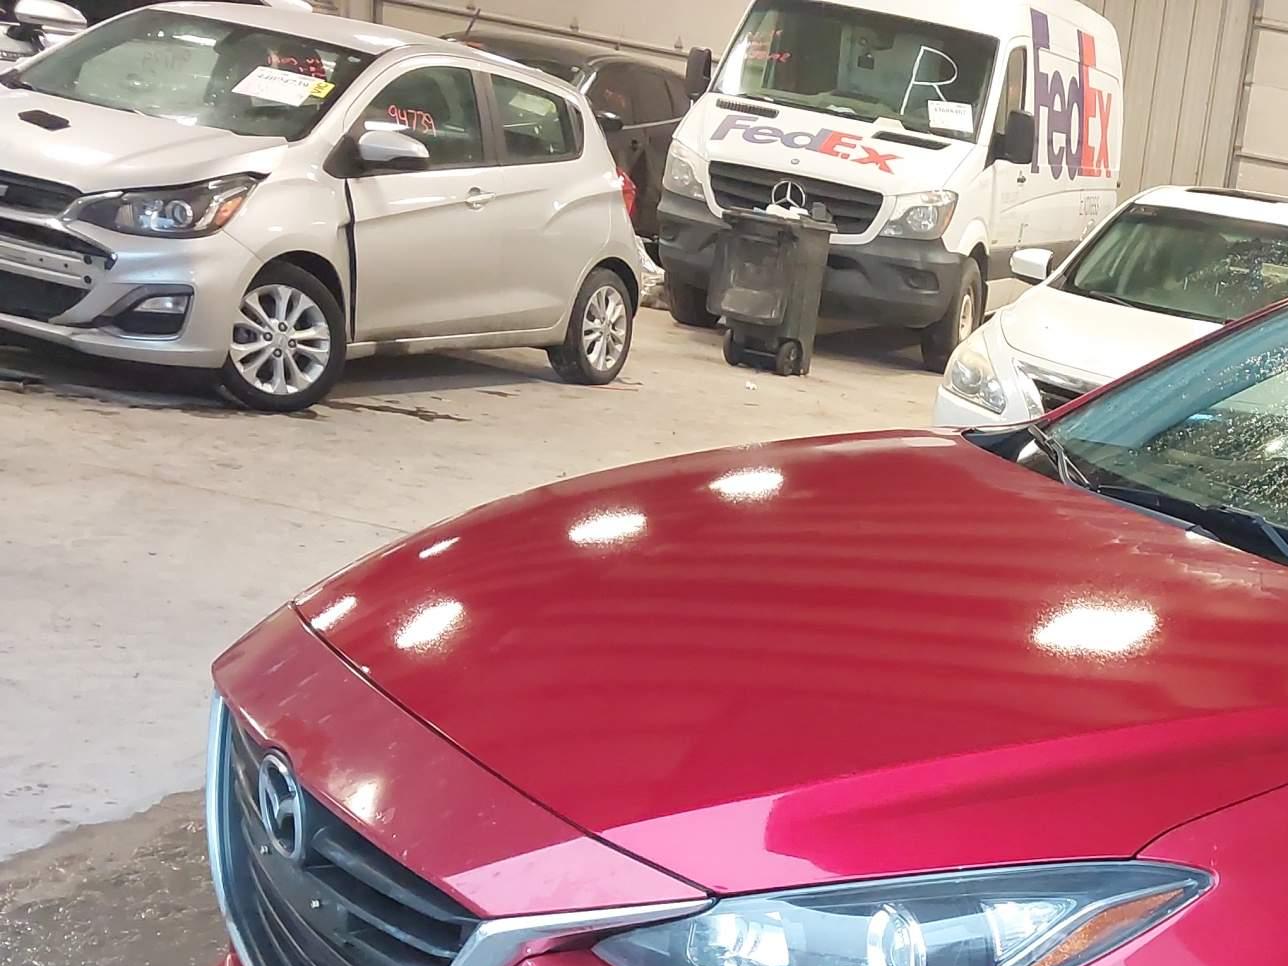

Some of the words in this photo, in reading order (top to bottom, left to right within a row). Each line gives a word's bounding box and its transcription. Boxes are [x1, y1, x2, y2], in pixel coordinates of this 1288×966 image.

[900, 46, 959, 116] R
[1030, 8, 1113, 180] FedEx
[388, 104, 437, 137] 94739
[710, 114, 904, 175] FedEx
